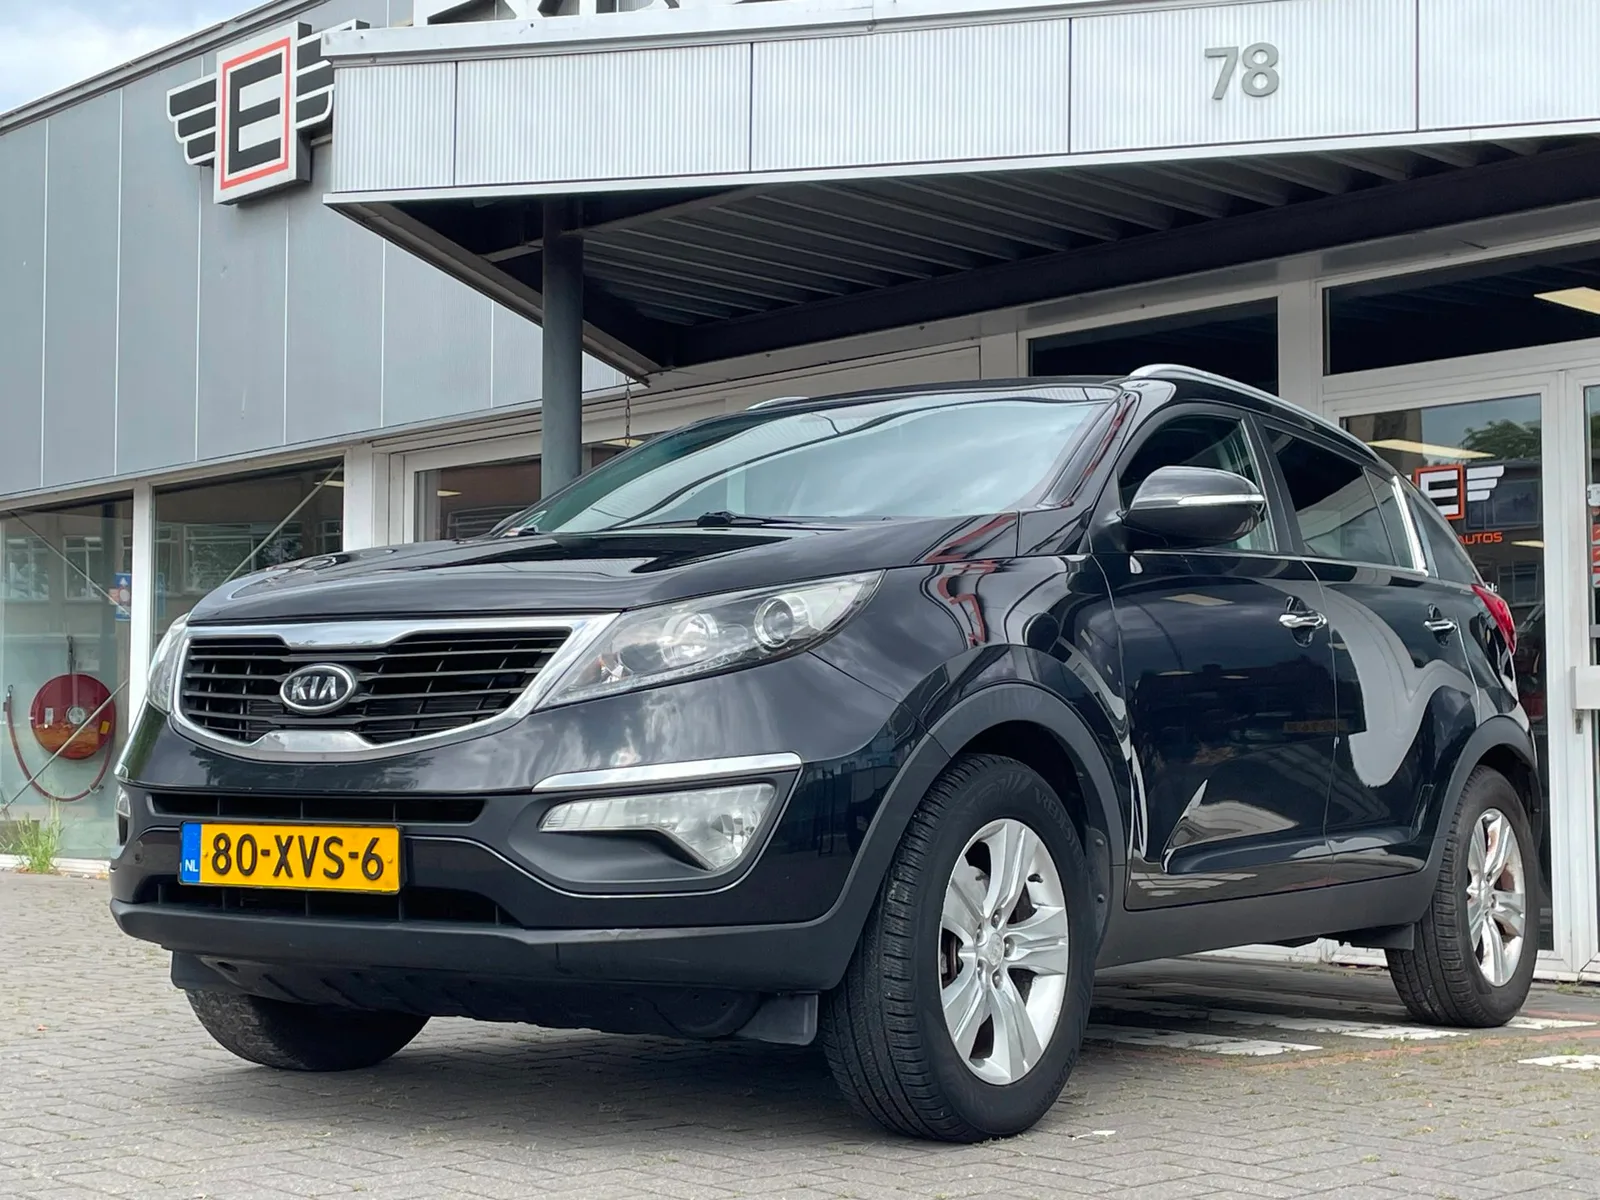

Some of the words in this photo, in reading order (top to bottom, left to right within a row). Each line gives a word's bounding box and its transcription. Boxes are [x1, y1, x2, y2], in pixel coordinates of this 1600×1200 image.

[1204, 42, 1280, 101] 78
[290, 676, 339, 701] KIA
[184, 859, 200, 874] NL
[211, 832, 385, 882] 80-XVS-6
